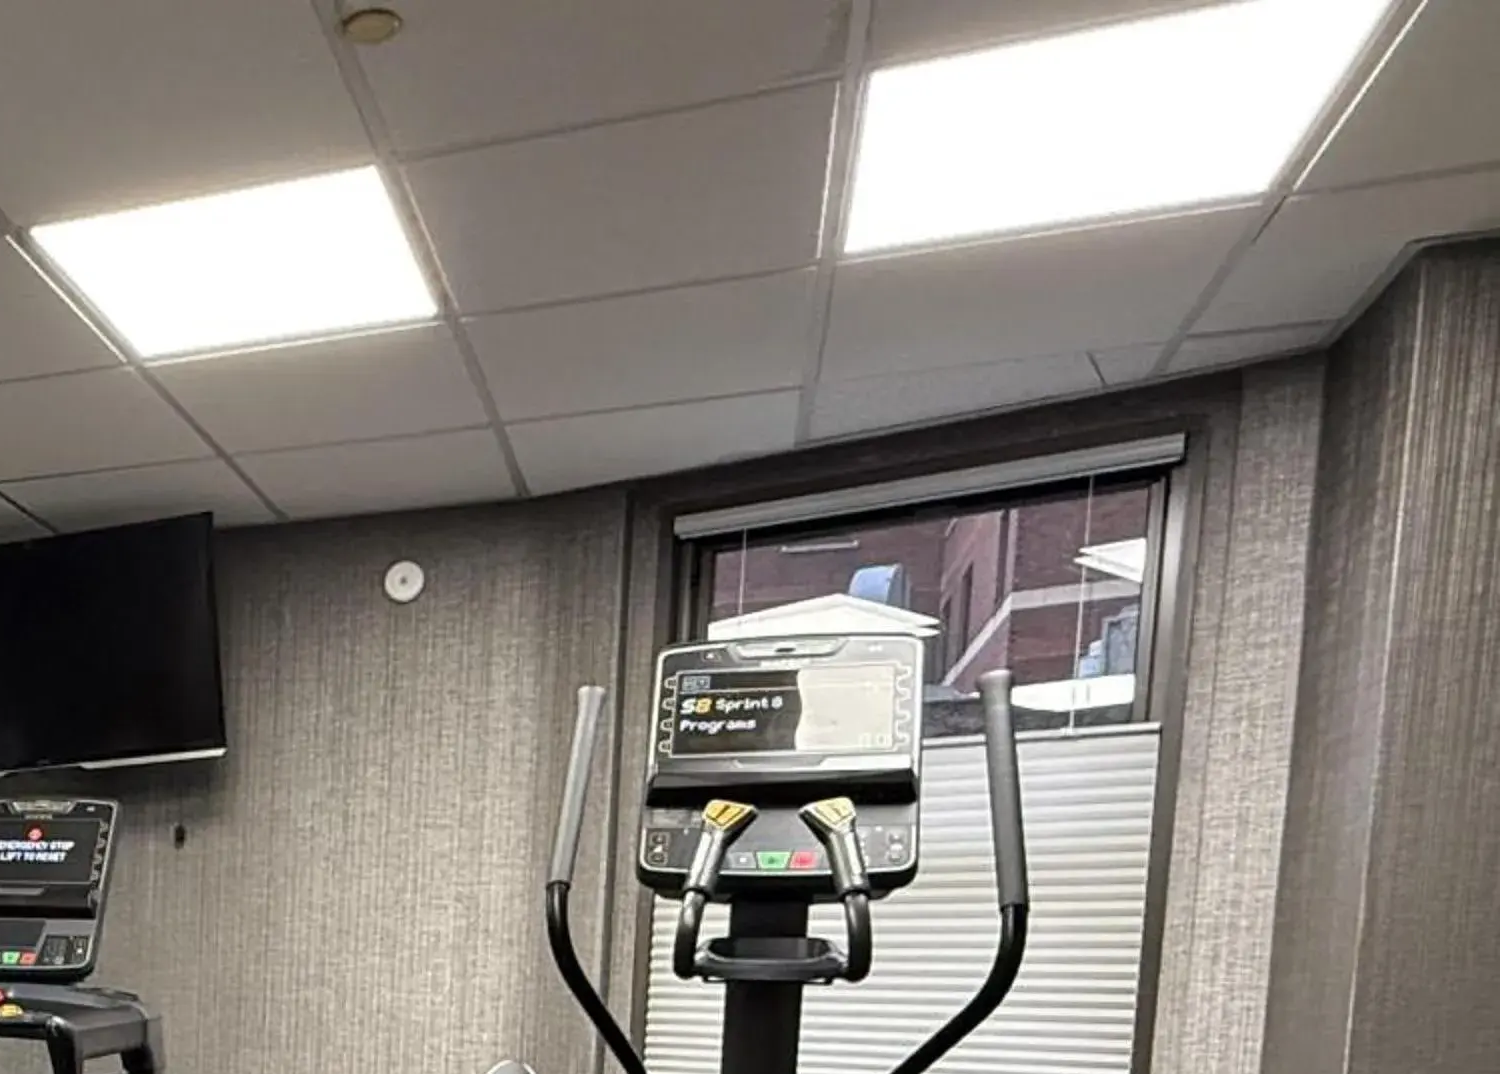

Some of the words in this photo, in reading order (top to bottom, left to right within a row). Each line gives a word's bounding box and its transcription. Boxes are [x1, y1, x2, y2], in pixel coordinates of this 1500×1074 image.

[715, 697, 769, 714] Sprint
[679, 719, 757, 735] Programs
[50, 840, 76, 851] STOP
[35, 851, 68, 862] RESET
